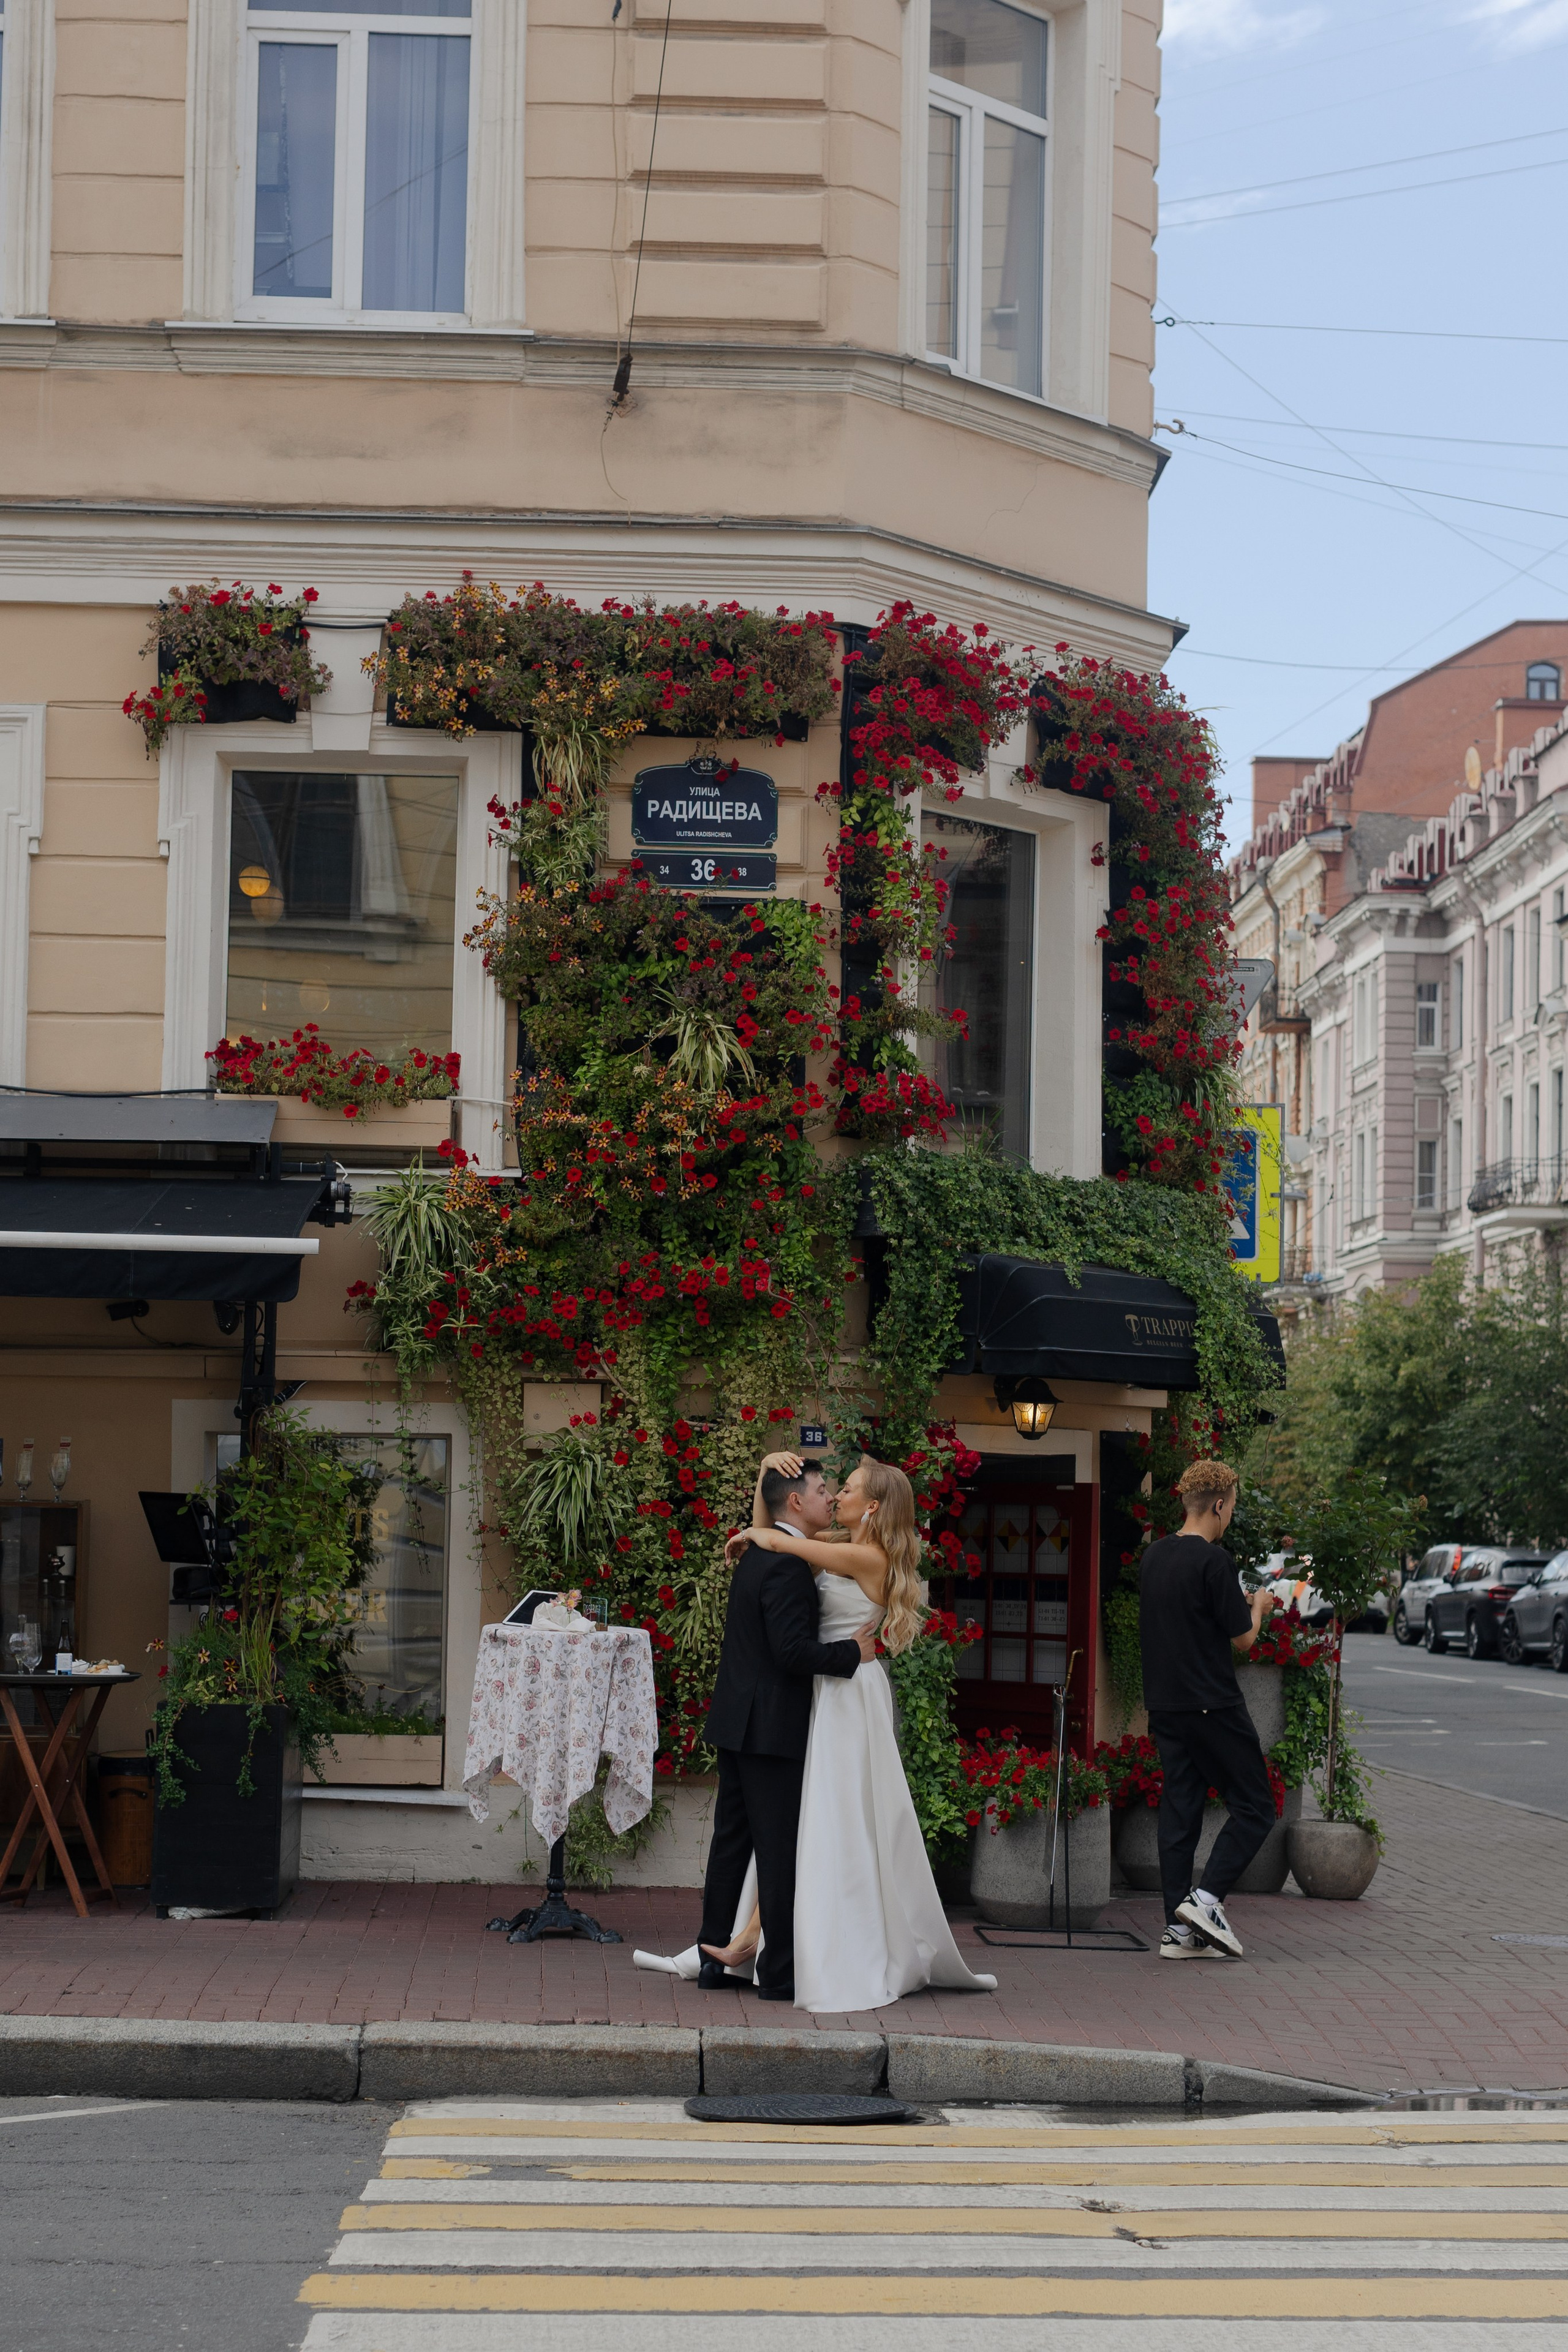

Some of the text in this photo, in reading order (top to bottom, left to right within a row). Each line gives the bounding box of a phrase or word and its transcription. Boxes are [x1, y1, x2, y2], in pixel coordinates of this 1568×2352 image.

[690, 786, 720, 797] УЛИЦА
[647, 800, 763, 823] РАДИЩЕВА
[660, 859, 747, 881] 34 36 38
[806, 1431, 822, 1442] 36
